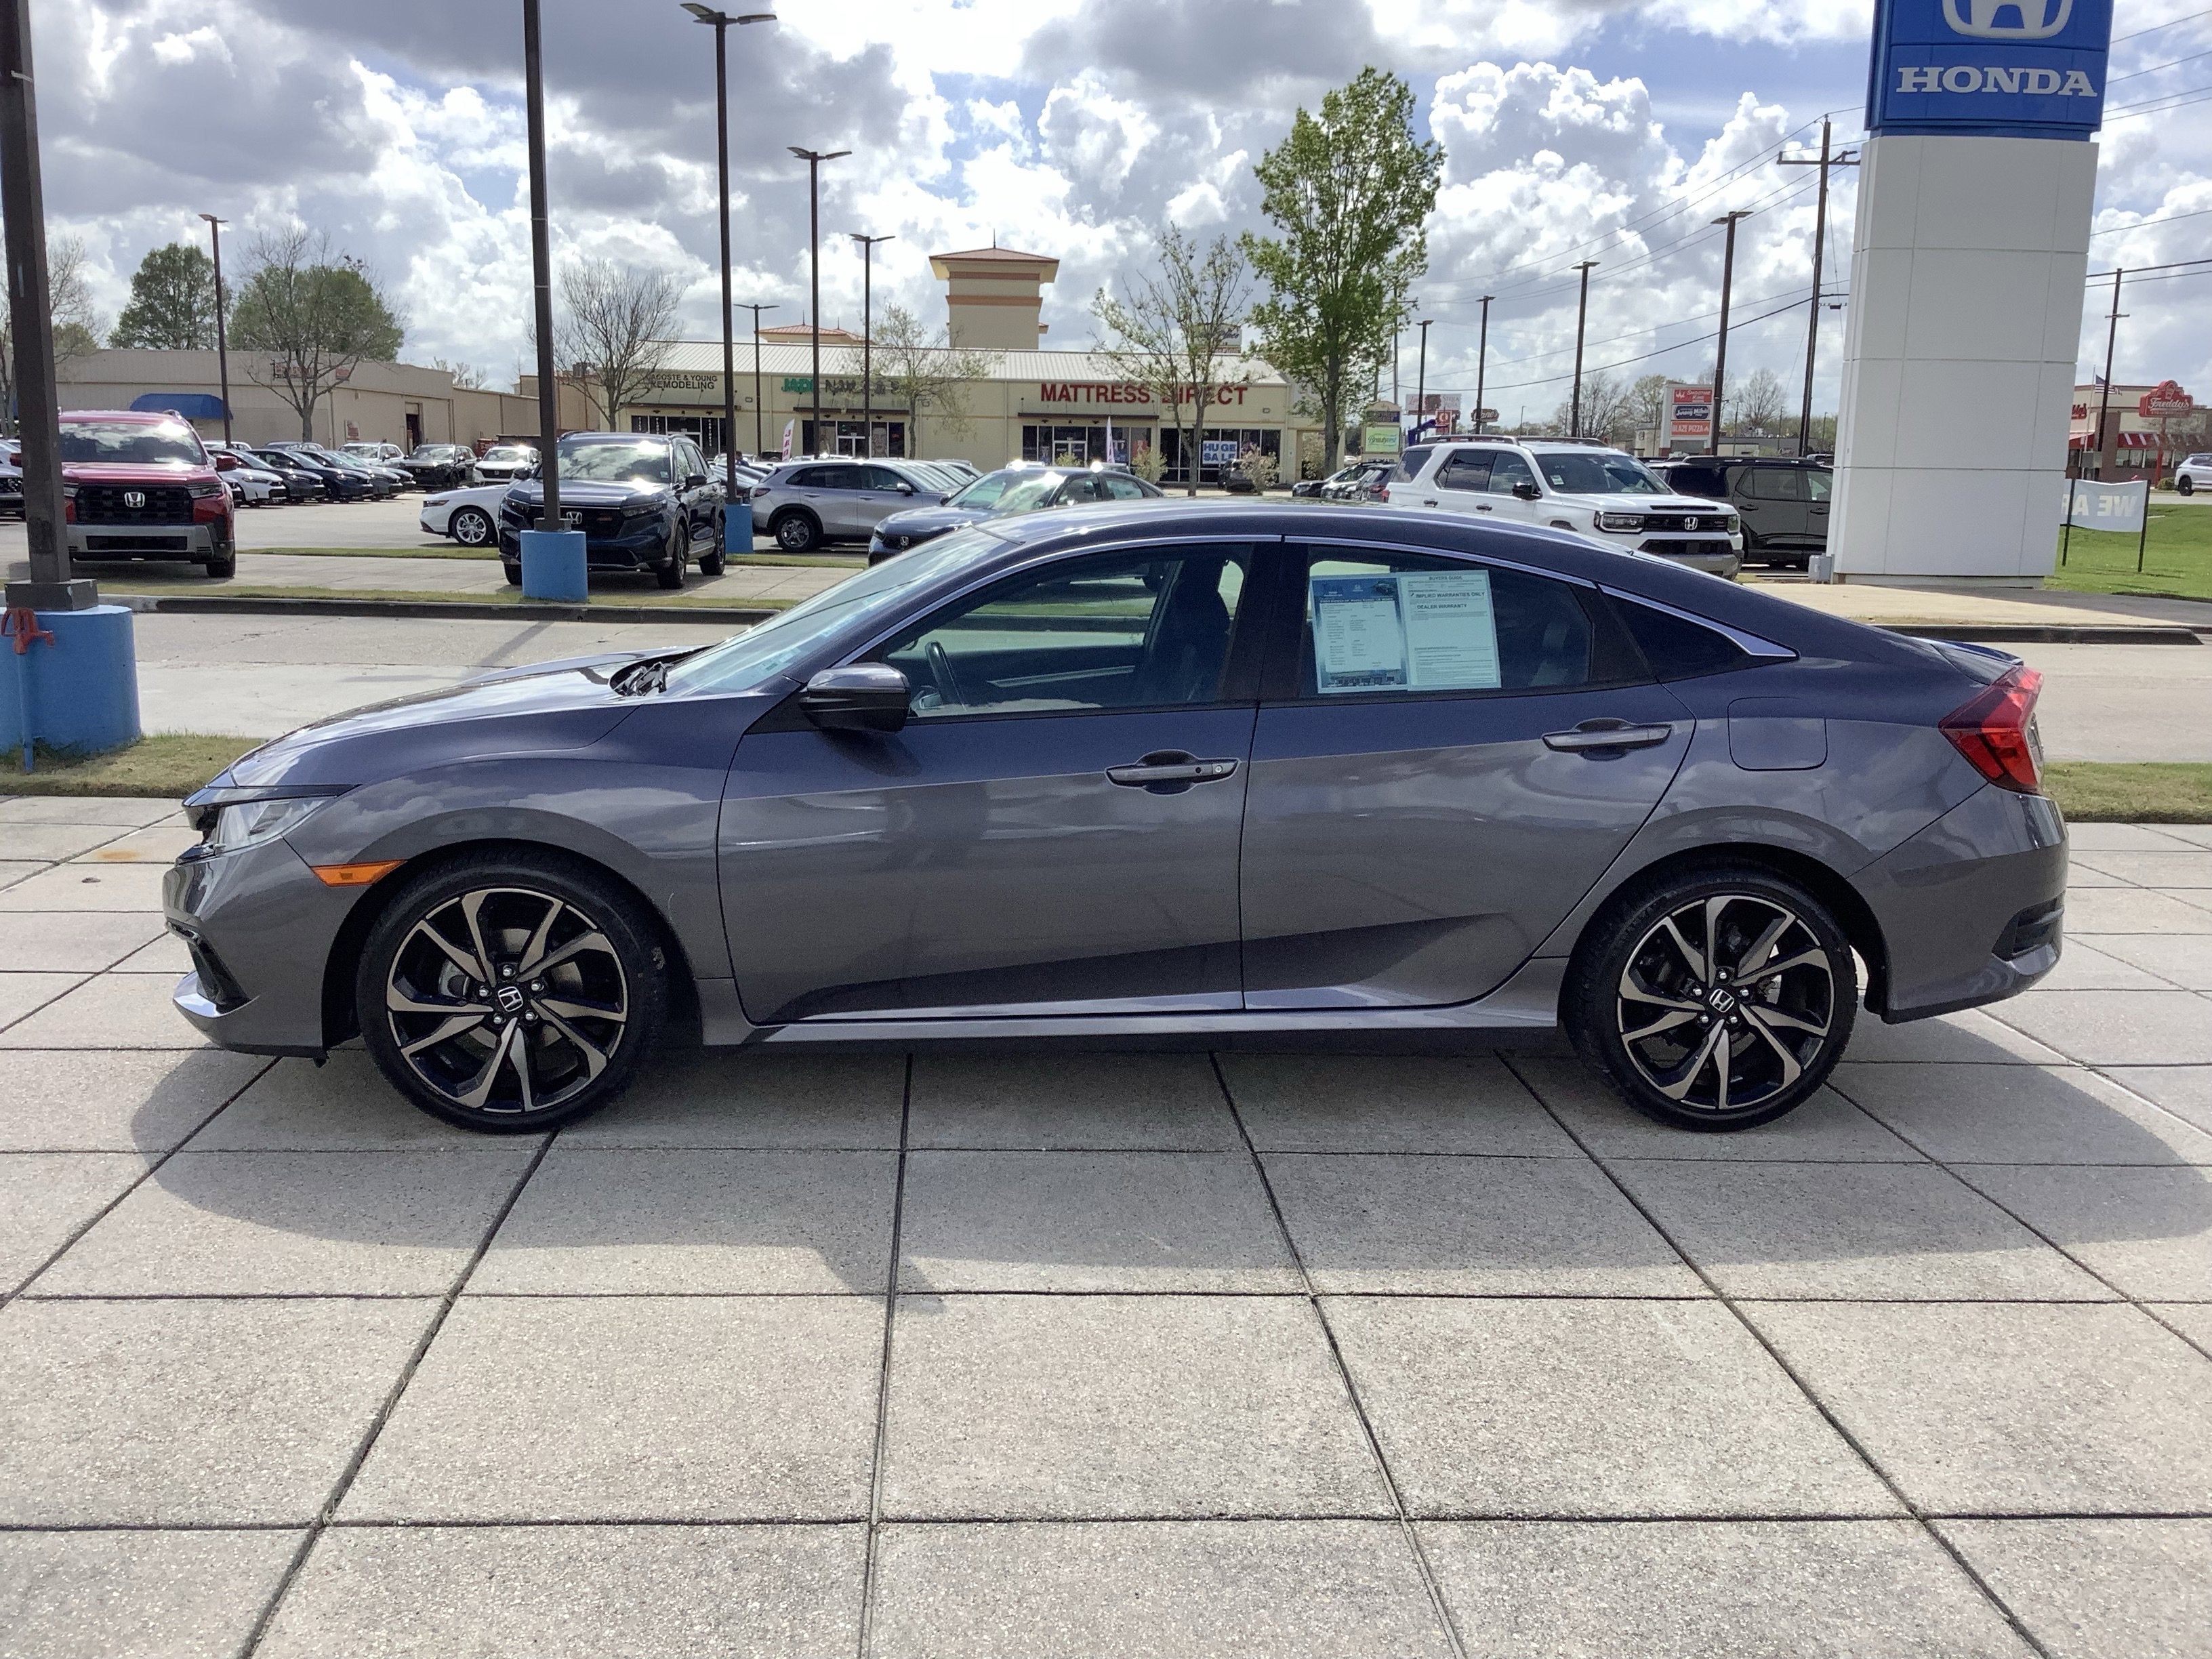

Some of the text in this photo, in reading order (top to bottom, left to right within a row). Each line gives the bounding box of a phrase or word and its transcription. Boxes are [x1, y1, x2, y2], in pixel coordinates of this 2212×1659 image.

[1896, 66, 2097, 97] HONDA
[651, 381, 715, 390] REMODELING
[781, 378, 814, 392] JAD
[825, 379, 869, 394] NAIL
[1040, 382, 1151, 404] MATTRESS
[2148, 397, 2190, 409] Freddy's
[1204, 443, 1237, 452] HUGE
[1204, 452, 1236, 462] SALE
